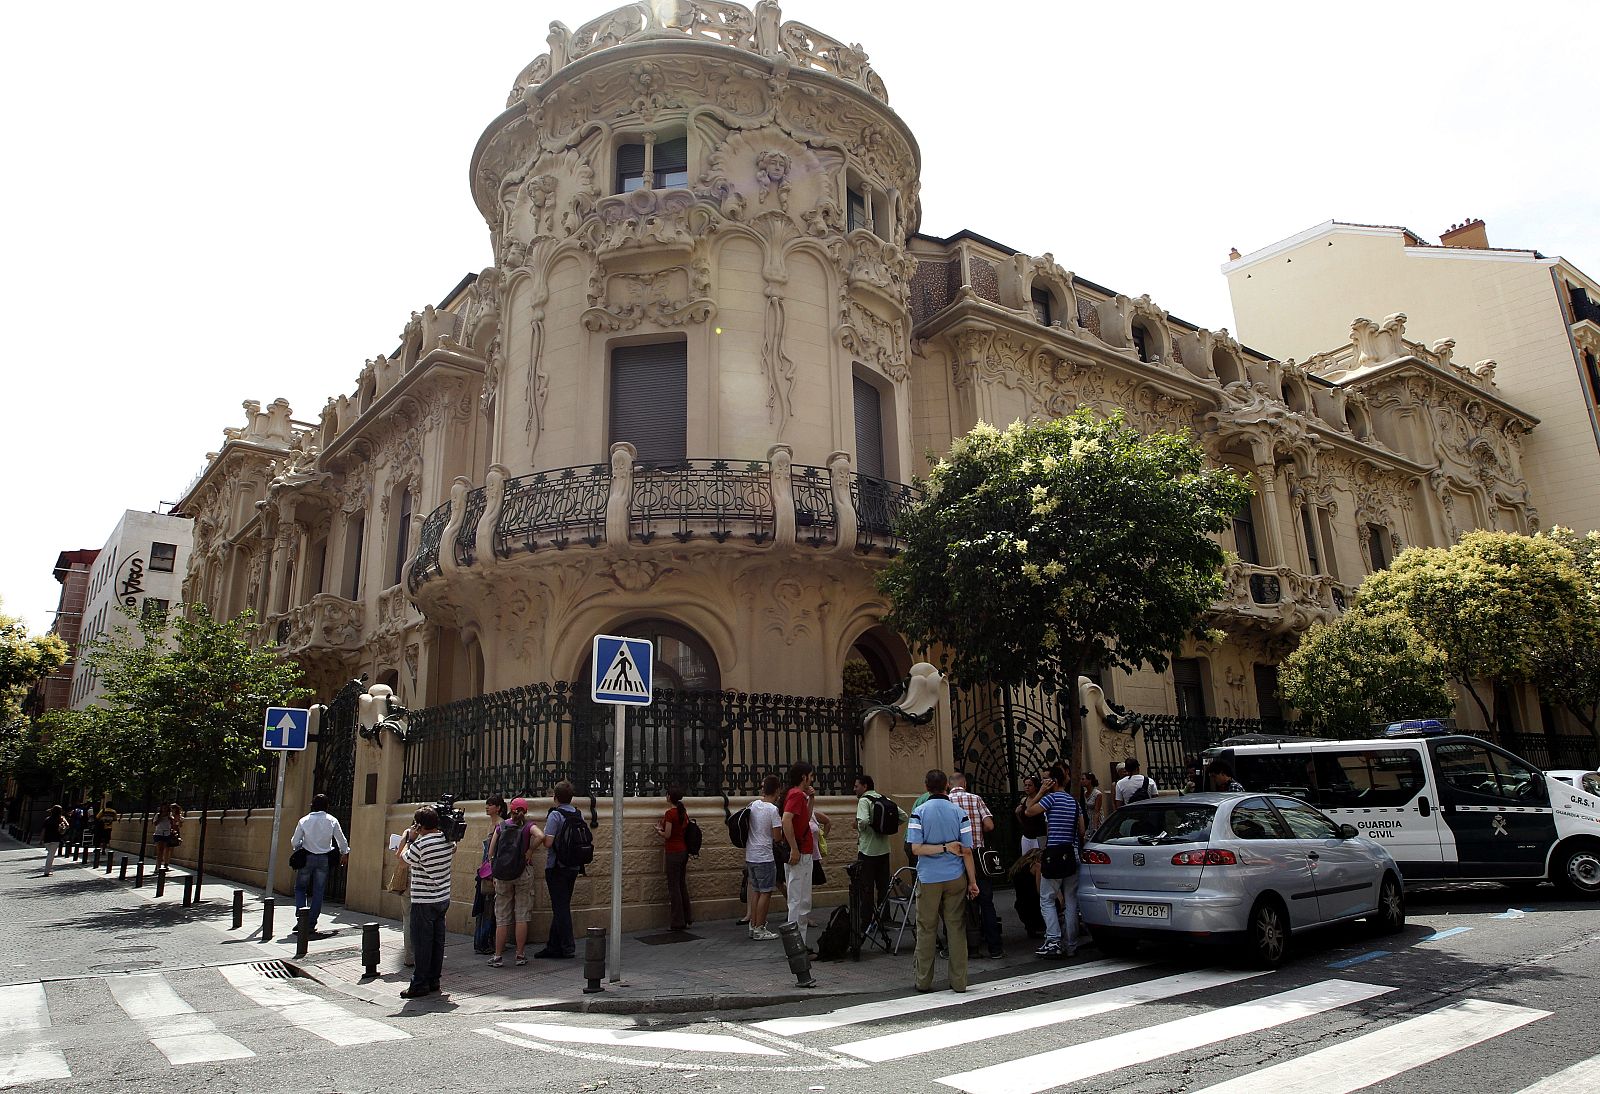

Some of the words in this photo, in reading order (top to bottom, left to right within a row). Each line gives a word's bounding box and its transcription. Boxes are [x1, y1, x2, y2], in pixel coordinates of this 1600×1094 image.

[1357, 820, 1402, 829] GUARDIA
[1368, 830, 1395, 839] CIVIL
[1121, 904, 1144, 916] 2749
[1147, 905, 1164, 917] CBY
